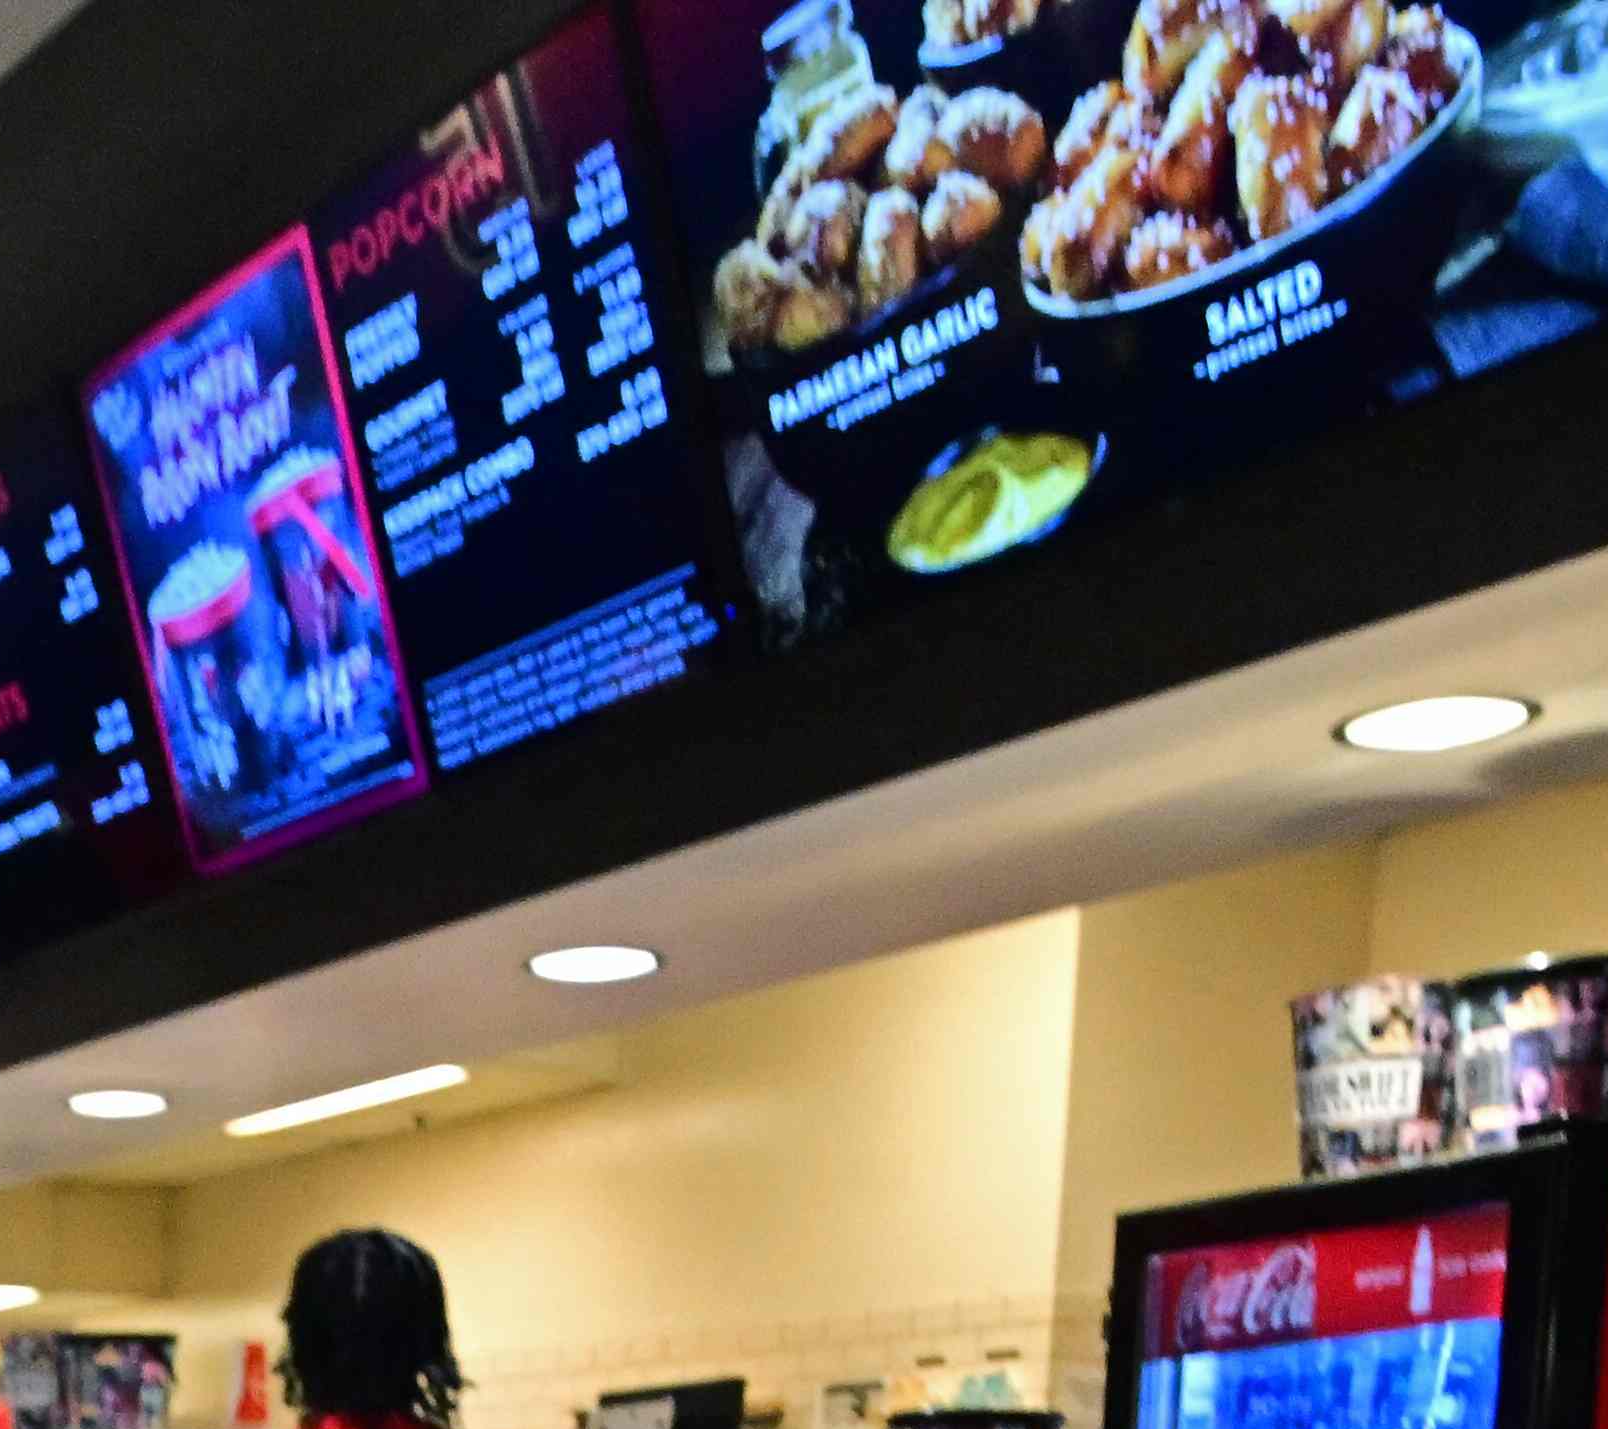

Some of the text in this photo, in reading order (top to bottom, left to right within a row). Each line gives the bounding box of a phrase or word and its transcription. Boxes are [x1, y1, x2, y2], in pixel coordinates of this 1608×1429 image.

[327, 134, 505, 290] POPCORN
[768, 337, 899, 432] PARMESAN
[900, 287, 999, 365] GARLIC
[1205, 260, 1322, 346] SALTED
